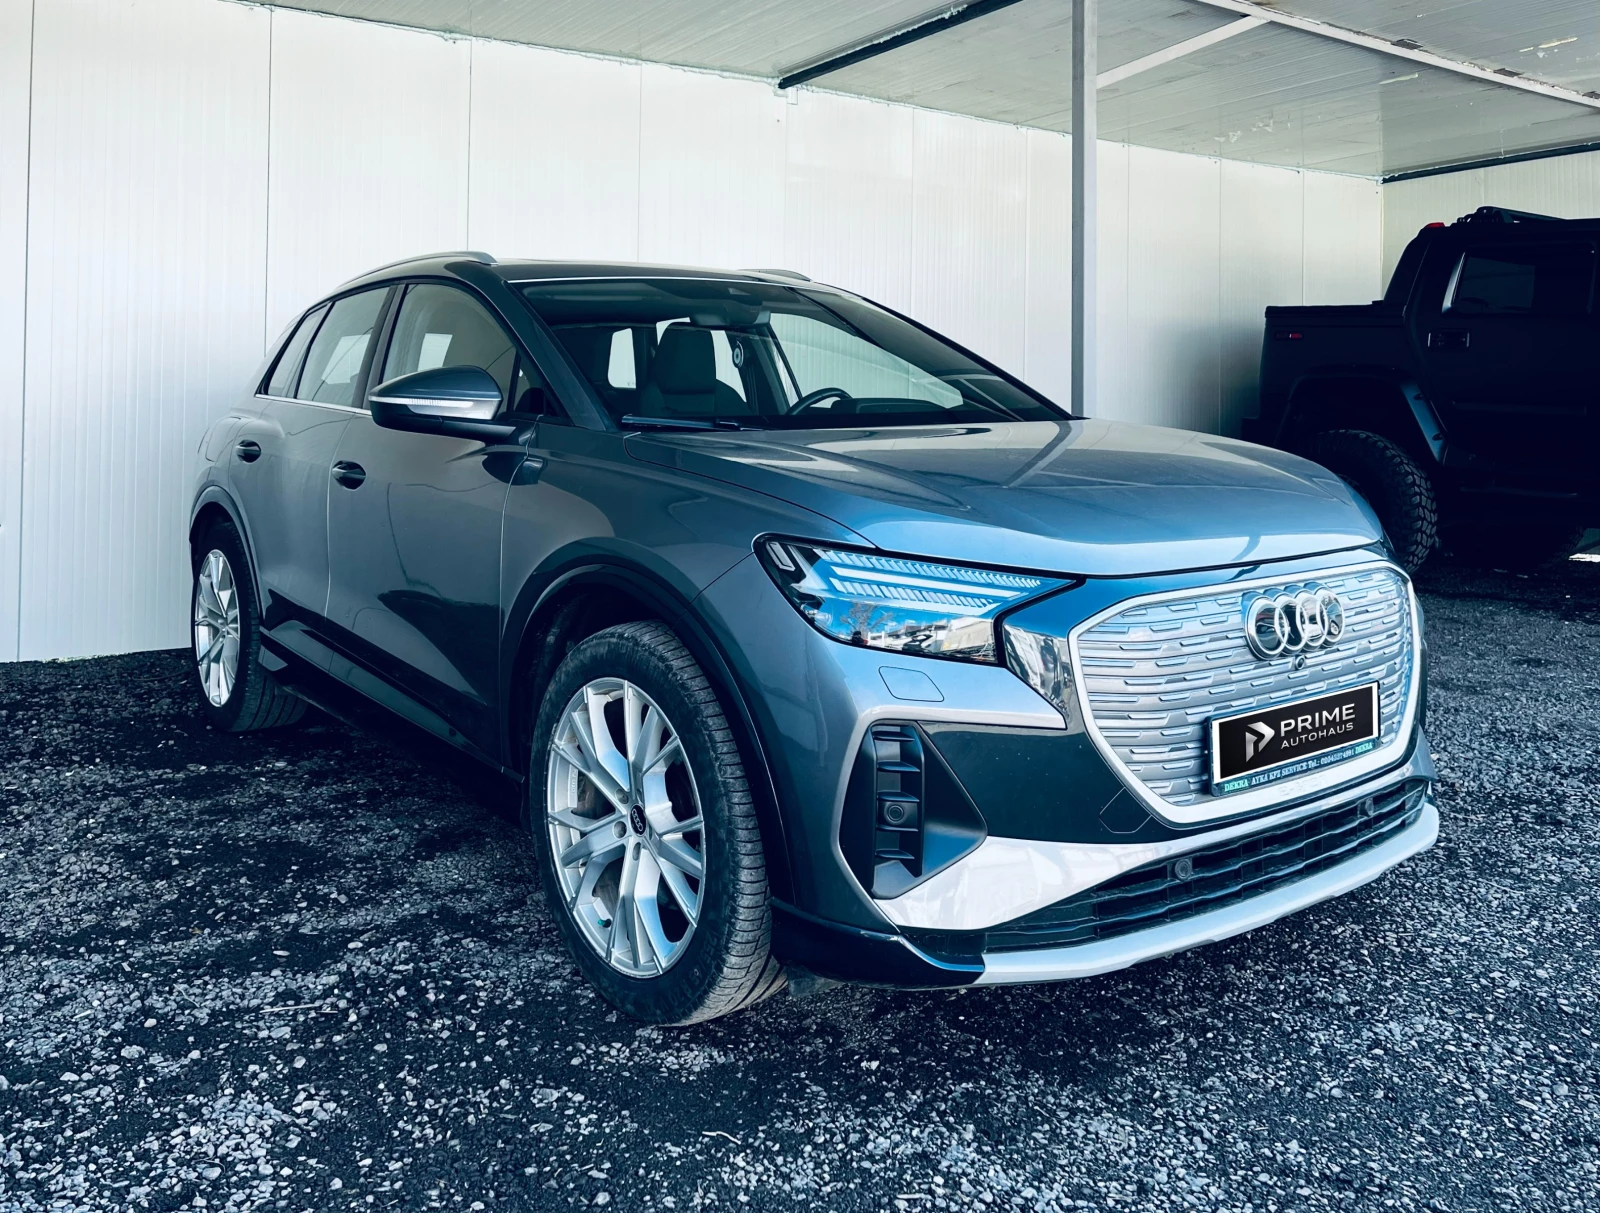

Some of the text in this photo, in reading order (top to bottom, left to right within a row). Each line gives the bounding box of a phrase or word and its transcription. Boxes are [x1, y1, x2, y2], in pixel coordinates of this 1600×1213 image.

[1280, 703, 1356, 737] PRIME
[1280, 722, 1354, 750] AUTOHAUS
[1224, 778, 1249, 792] DEKRA
[1281, 762, 1308, 777] SERVICE
[1355, 742, 1373, 754] DEKRA
